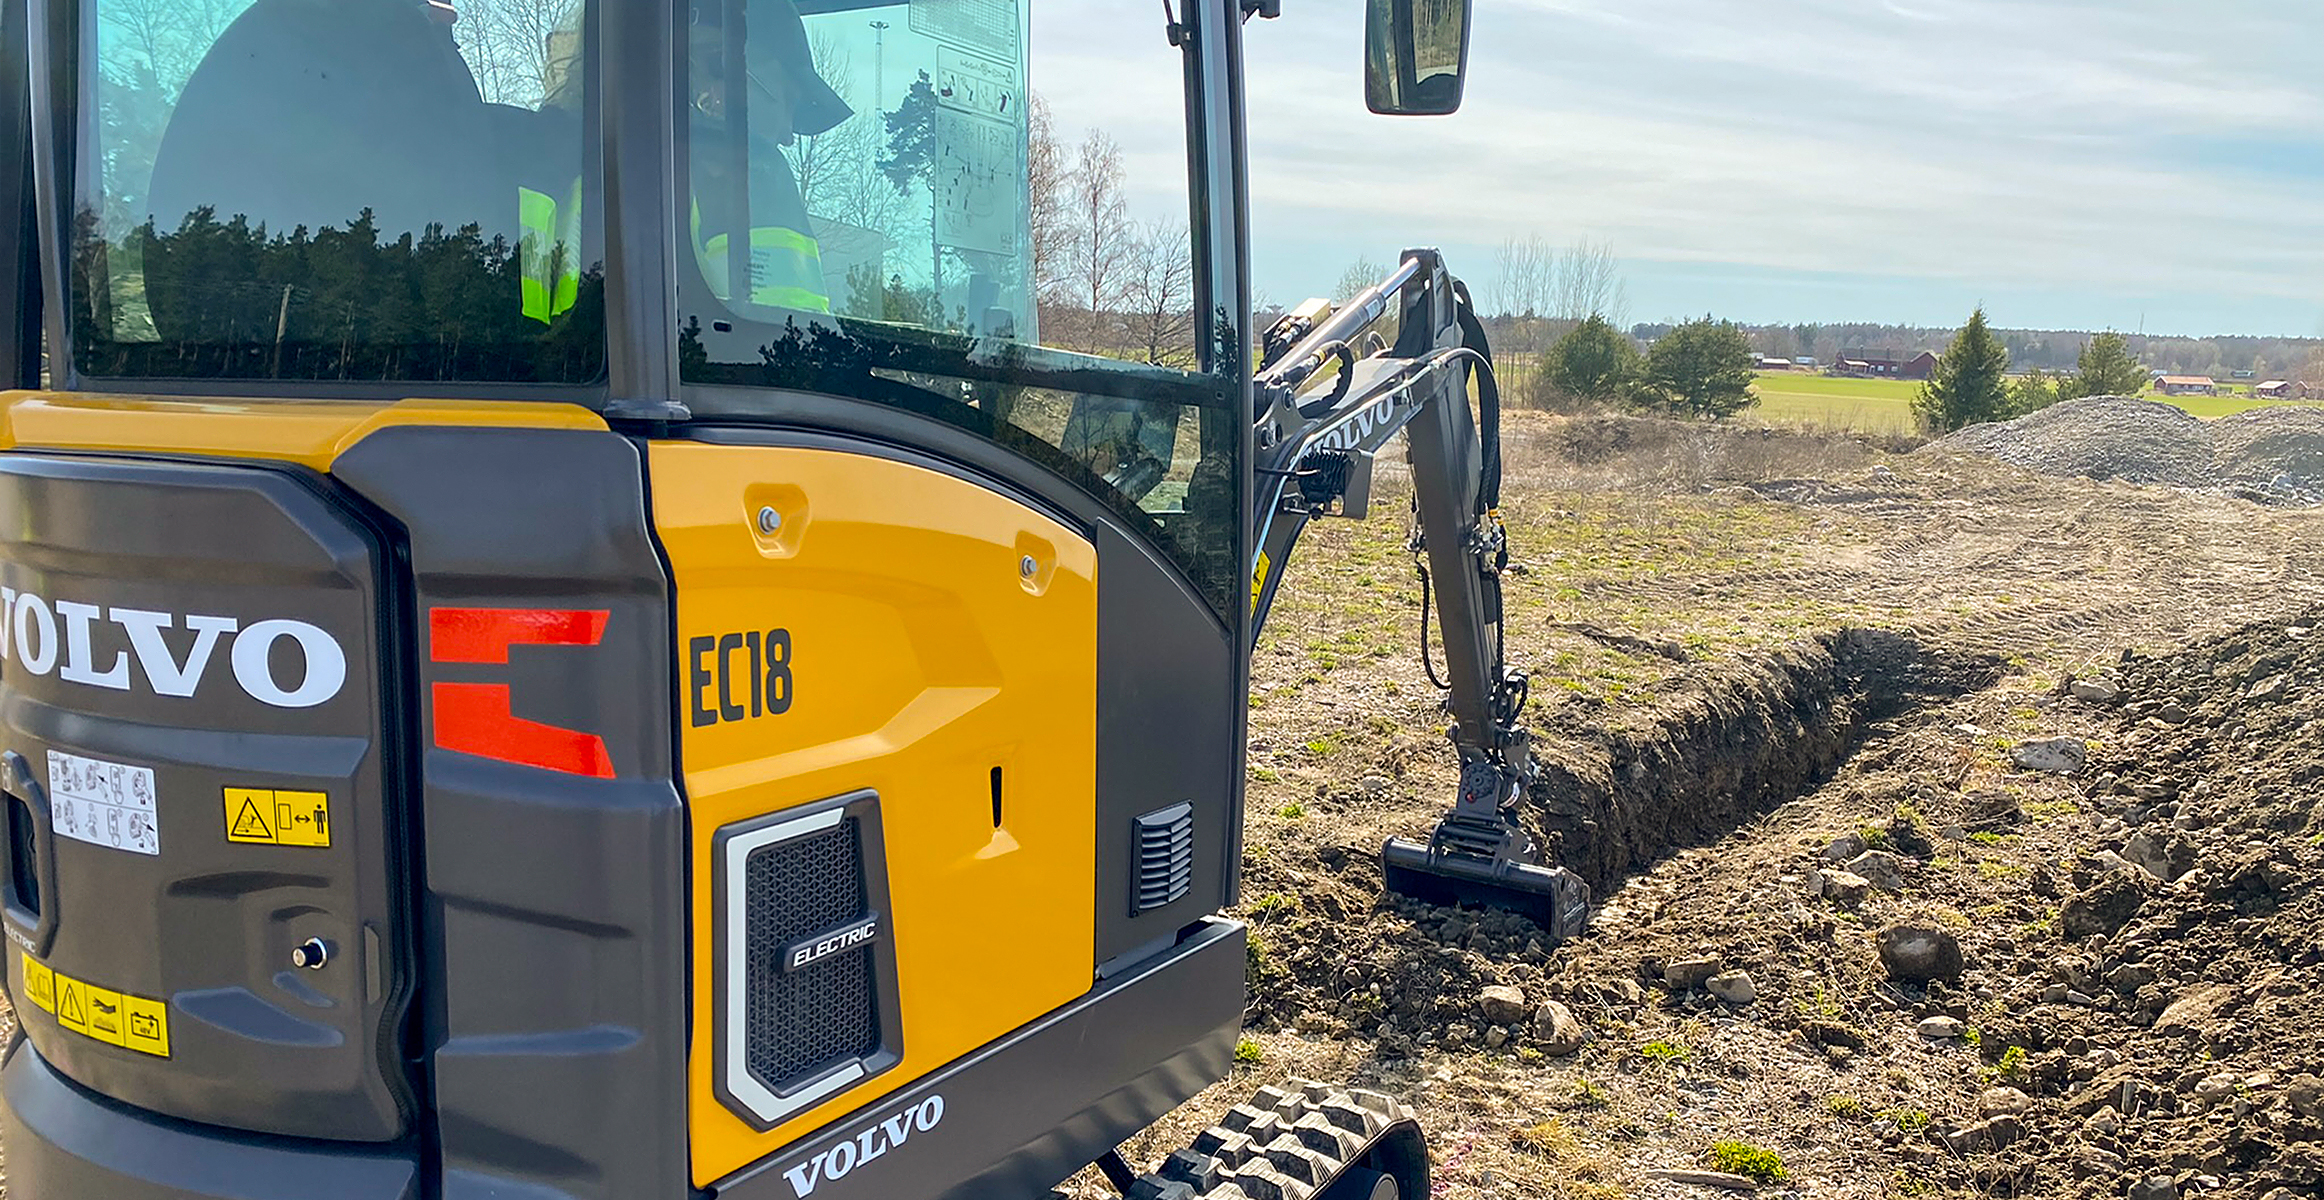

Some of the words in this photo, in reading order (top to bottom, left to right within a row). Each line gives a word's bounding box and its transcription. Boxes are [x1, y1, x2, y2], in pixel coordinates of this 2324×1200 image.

[690, 628, 793, 728] EC18
[793, 922, 876, 967] ELECTRIC
[783, 1094, 944, 1199] VOLVO
